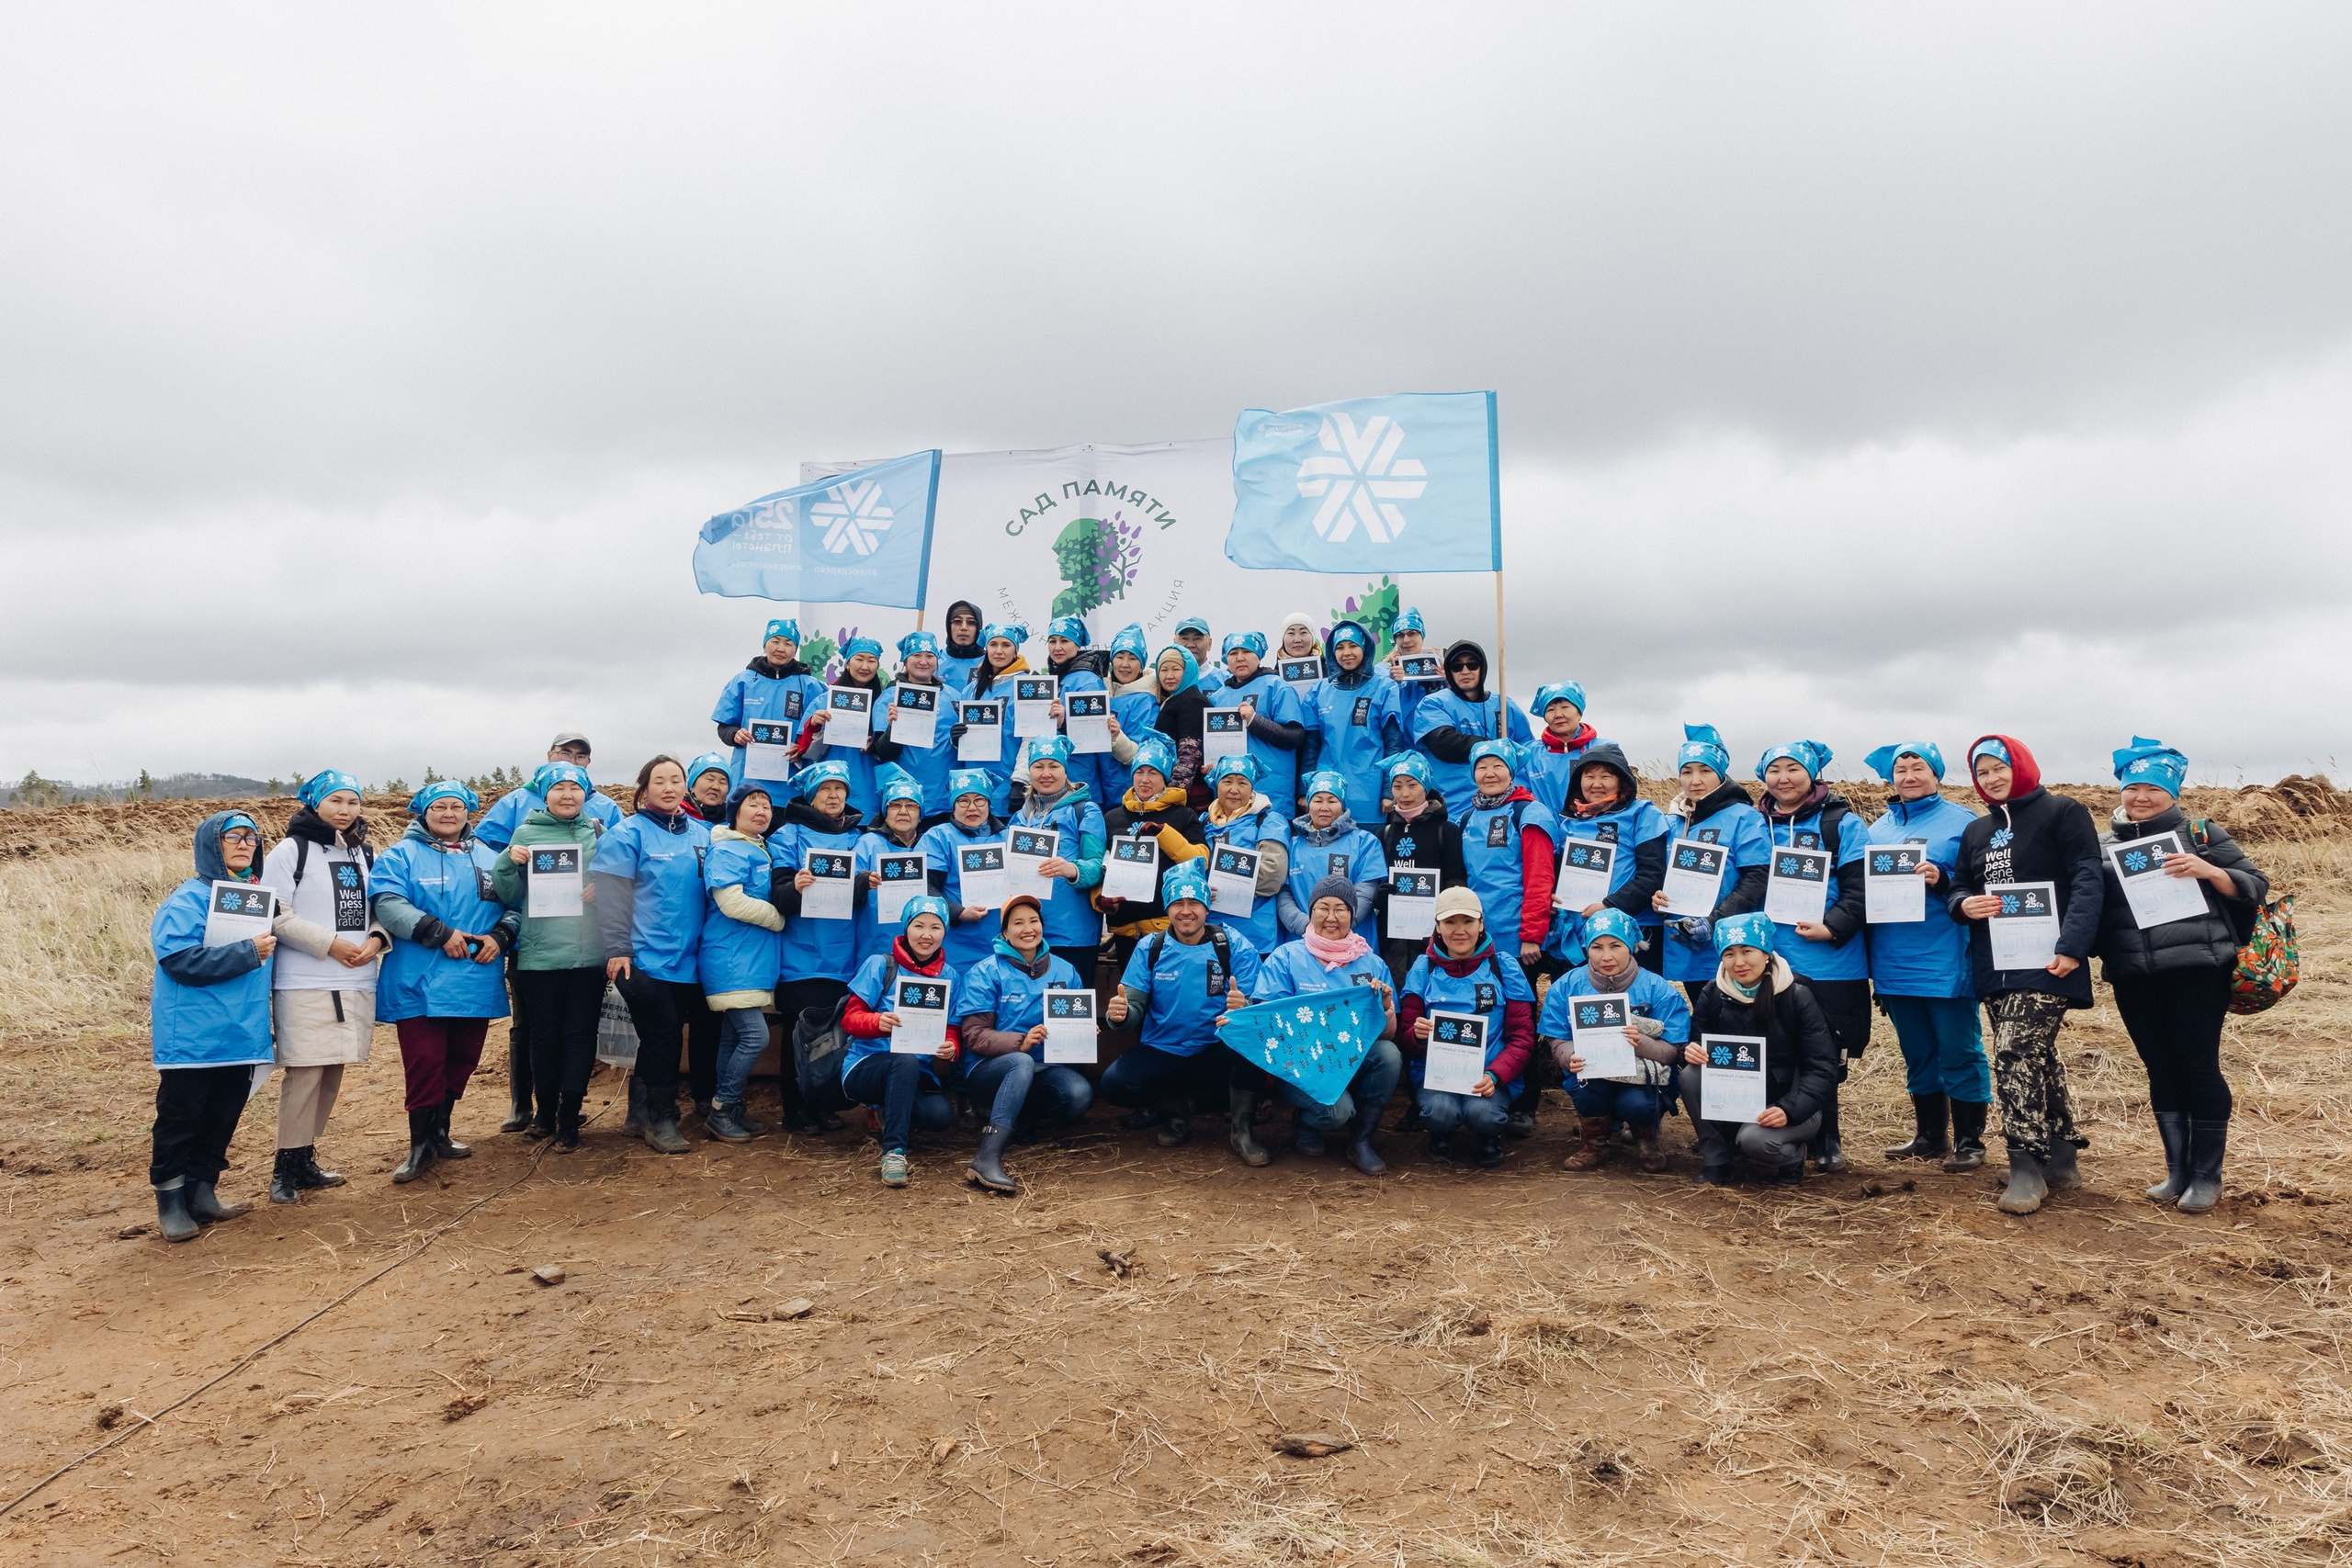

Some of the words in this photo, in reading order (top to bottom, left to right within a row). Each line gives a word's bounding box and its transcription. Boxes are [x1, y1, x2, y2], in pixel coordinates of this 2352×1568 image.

[1005, 492, 1057, 536] САД
[1062, 479, 1177, 531] ПАМЯТИ
[1147, 579, 1185, 632] АКЦИЯ
[1985, 848, 2011, 863] Well
[1394, 860, 1415, 869] Well
[1985, 859, 2011, 872] ness
[1984, 868, 2013, 881] Gene
[339, 889, 363, 900] Well
[340, 900, 363, 909] ness
[338, 908, 365, 918] Gene
[338, 916, 365, 927] ration
[601, 1011, 634, 1023] ELLNES
